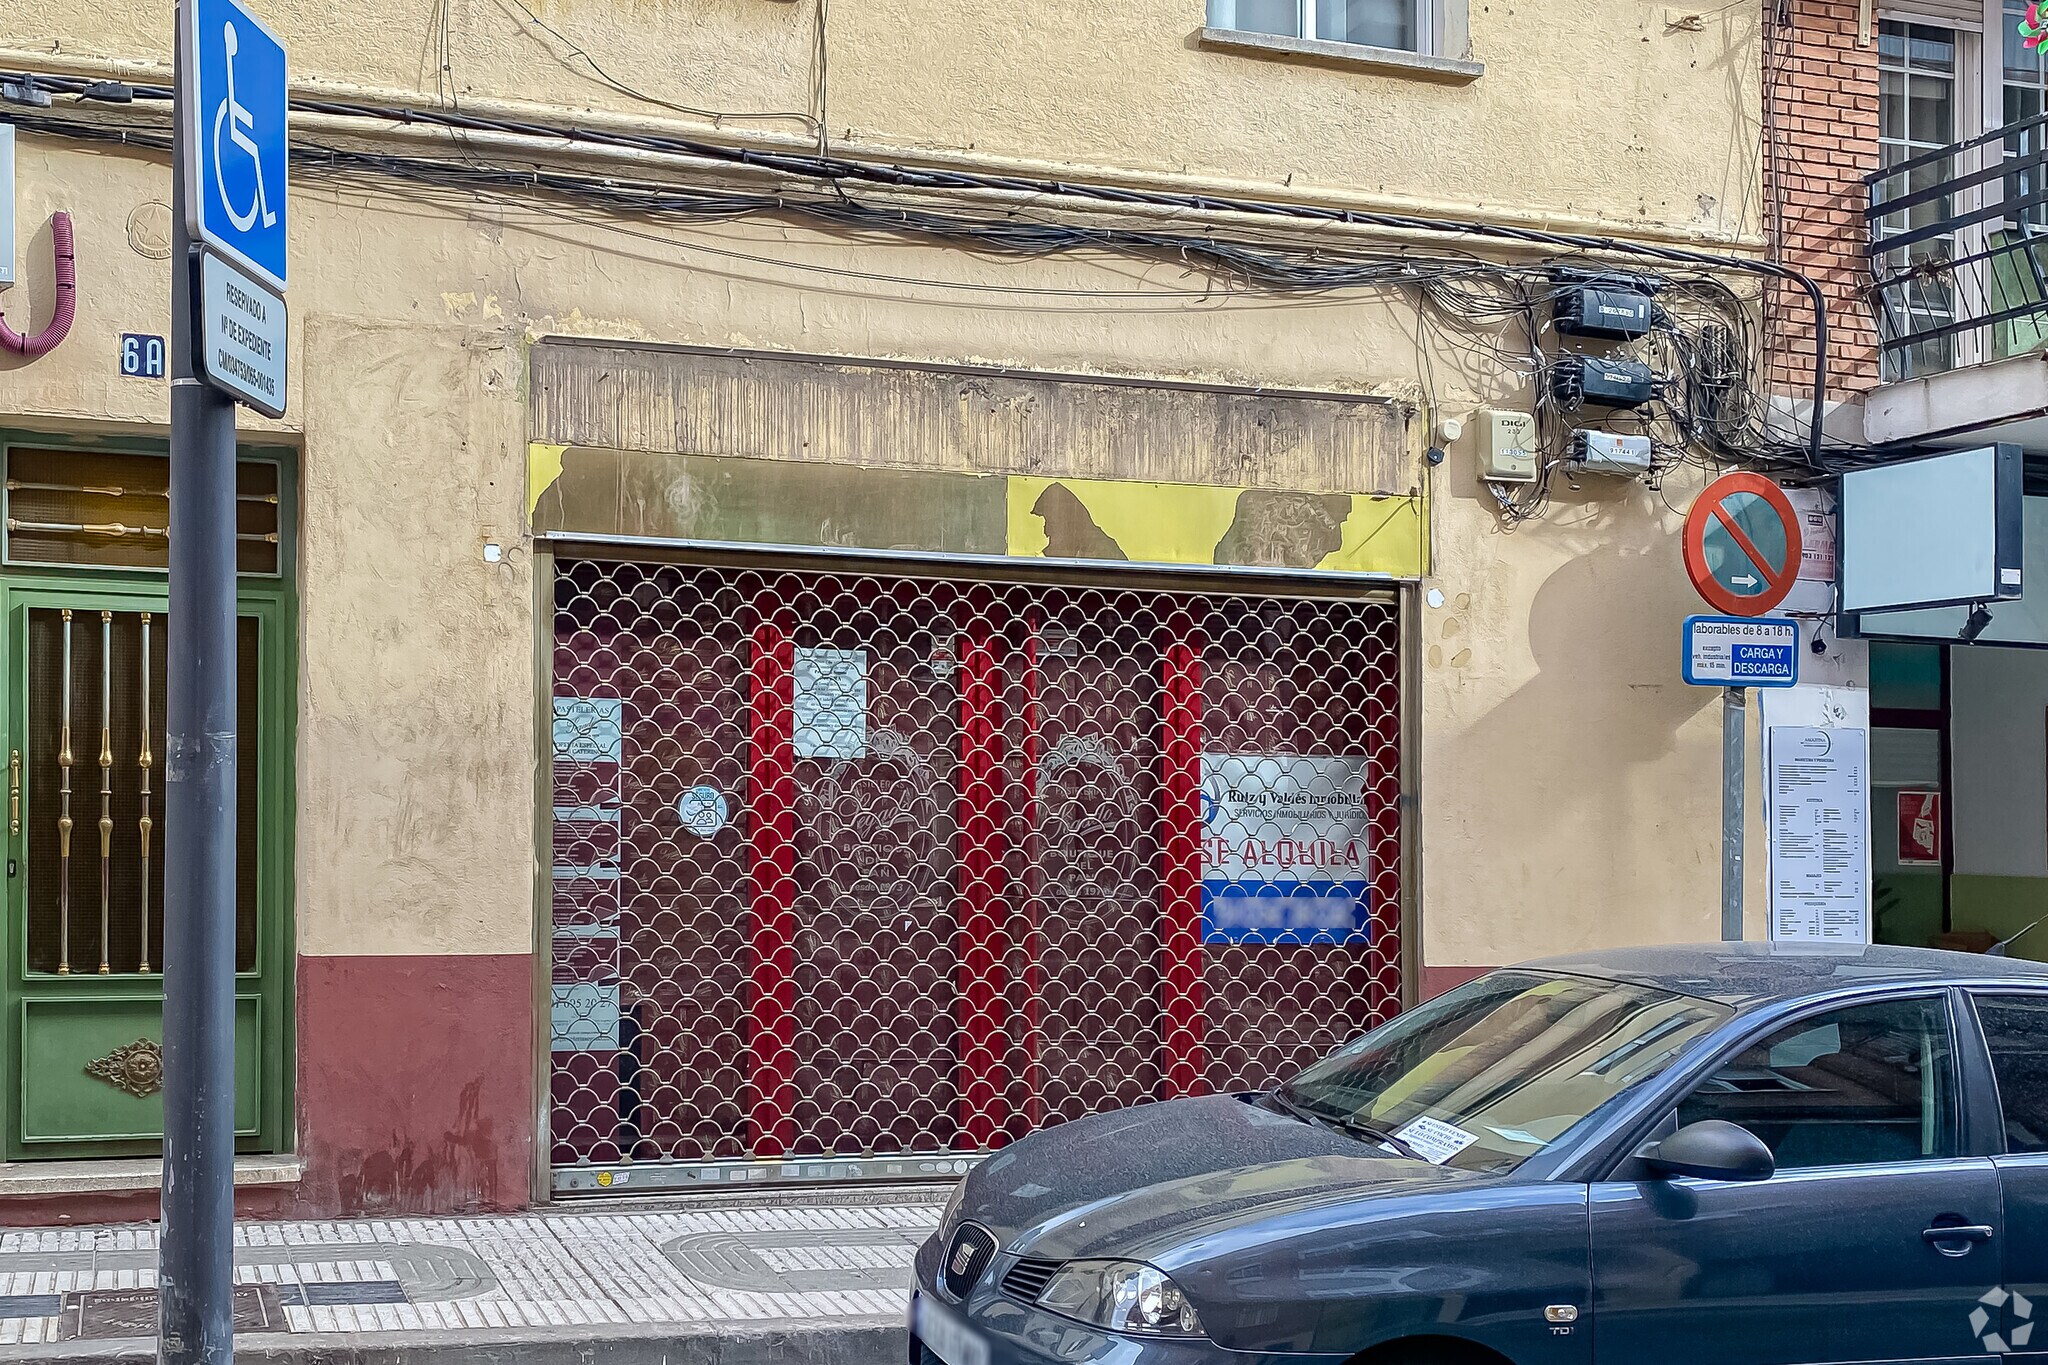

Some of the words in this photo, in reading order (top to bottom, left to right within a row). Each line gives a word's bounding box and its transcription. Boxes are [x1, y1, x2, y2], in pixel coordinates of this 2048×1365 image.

[226, 281, 261, 321] RESERVADO
[262, 305, 267, 325] A
[229, 320, 237, 342] DE
[238, 325, 272, 362] EXPEDIENTE
[1501, 420, 1526, 428] DIGI
[1693, 623, 1741, 635] laborables
[1742, 625, 1755, 636] de
[1756, 626, 1763, 636] 8
[1764, 628, 1770, 636] a
[1773, 626, 1783, 636] 18
[1785, 626, 1793, 637] h.
[1740, 647, 1775, 659] CARGA
[1776, 648, 1784, 660] Y
[1734, 662, 1790, 675] DESCARGA
[556, 705, 610, 714] PASTELERAS
[850, 779, 905, 788] PSTEERAS
[1227, 790, 1254, 803] Ruiz
[1259, 795, 1266, 806] y
[1270, 791, 1306, 805] Valdés
[1234, 808, 1273, 819] SERVICIOS
[1274, 809, 1326, 819] INMOBILIARIOS
[1200, 839, 1230, 864] SE
[1243, 840, 1360, 866] ALQUILA
